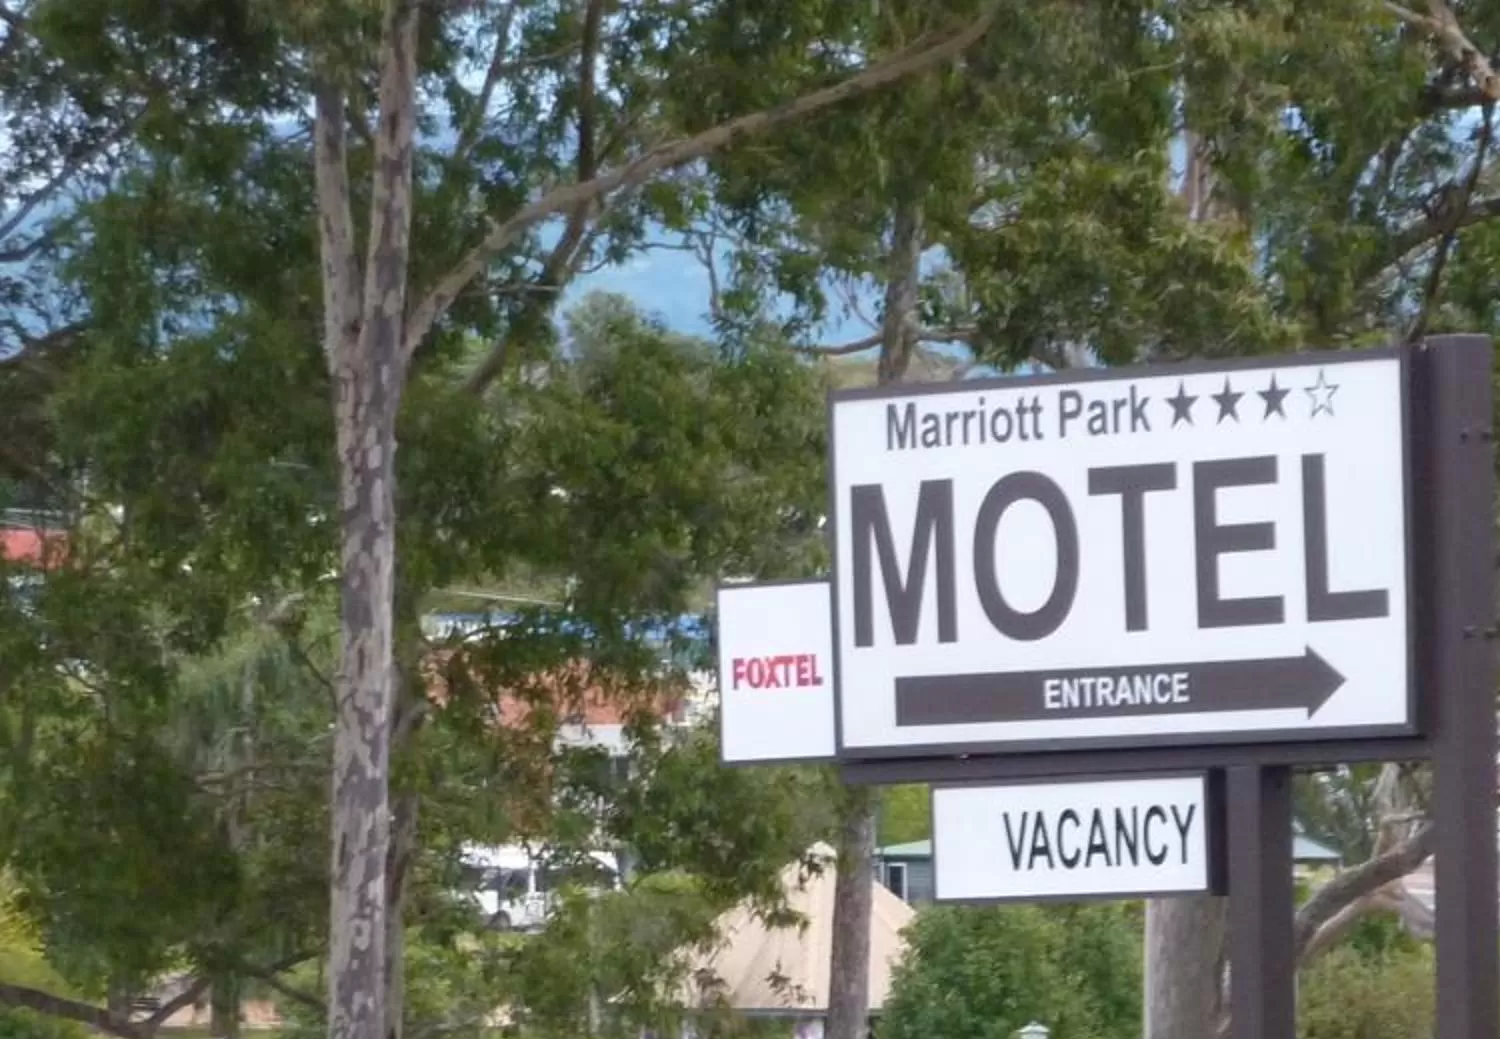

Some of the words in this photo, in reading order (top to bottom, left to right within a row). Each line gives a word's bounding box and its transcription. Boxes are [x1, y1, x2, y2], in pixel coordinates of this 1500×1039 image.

[886, 391, 1044, 452] Marriott
[1058, 384, 1152, 440] Park
[850, 453, 1390, 648] MOTEL
[731, 654, 824, 690] FOXTEL
[1044, 673, 1190, 710] ENTRANCE
[1002, 803, 1197, 872] VACANCY
